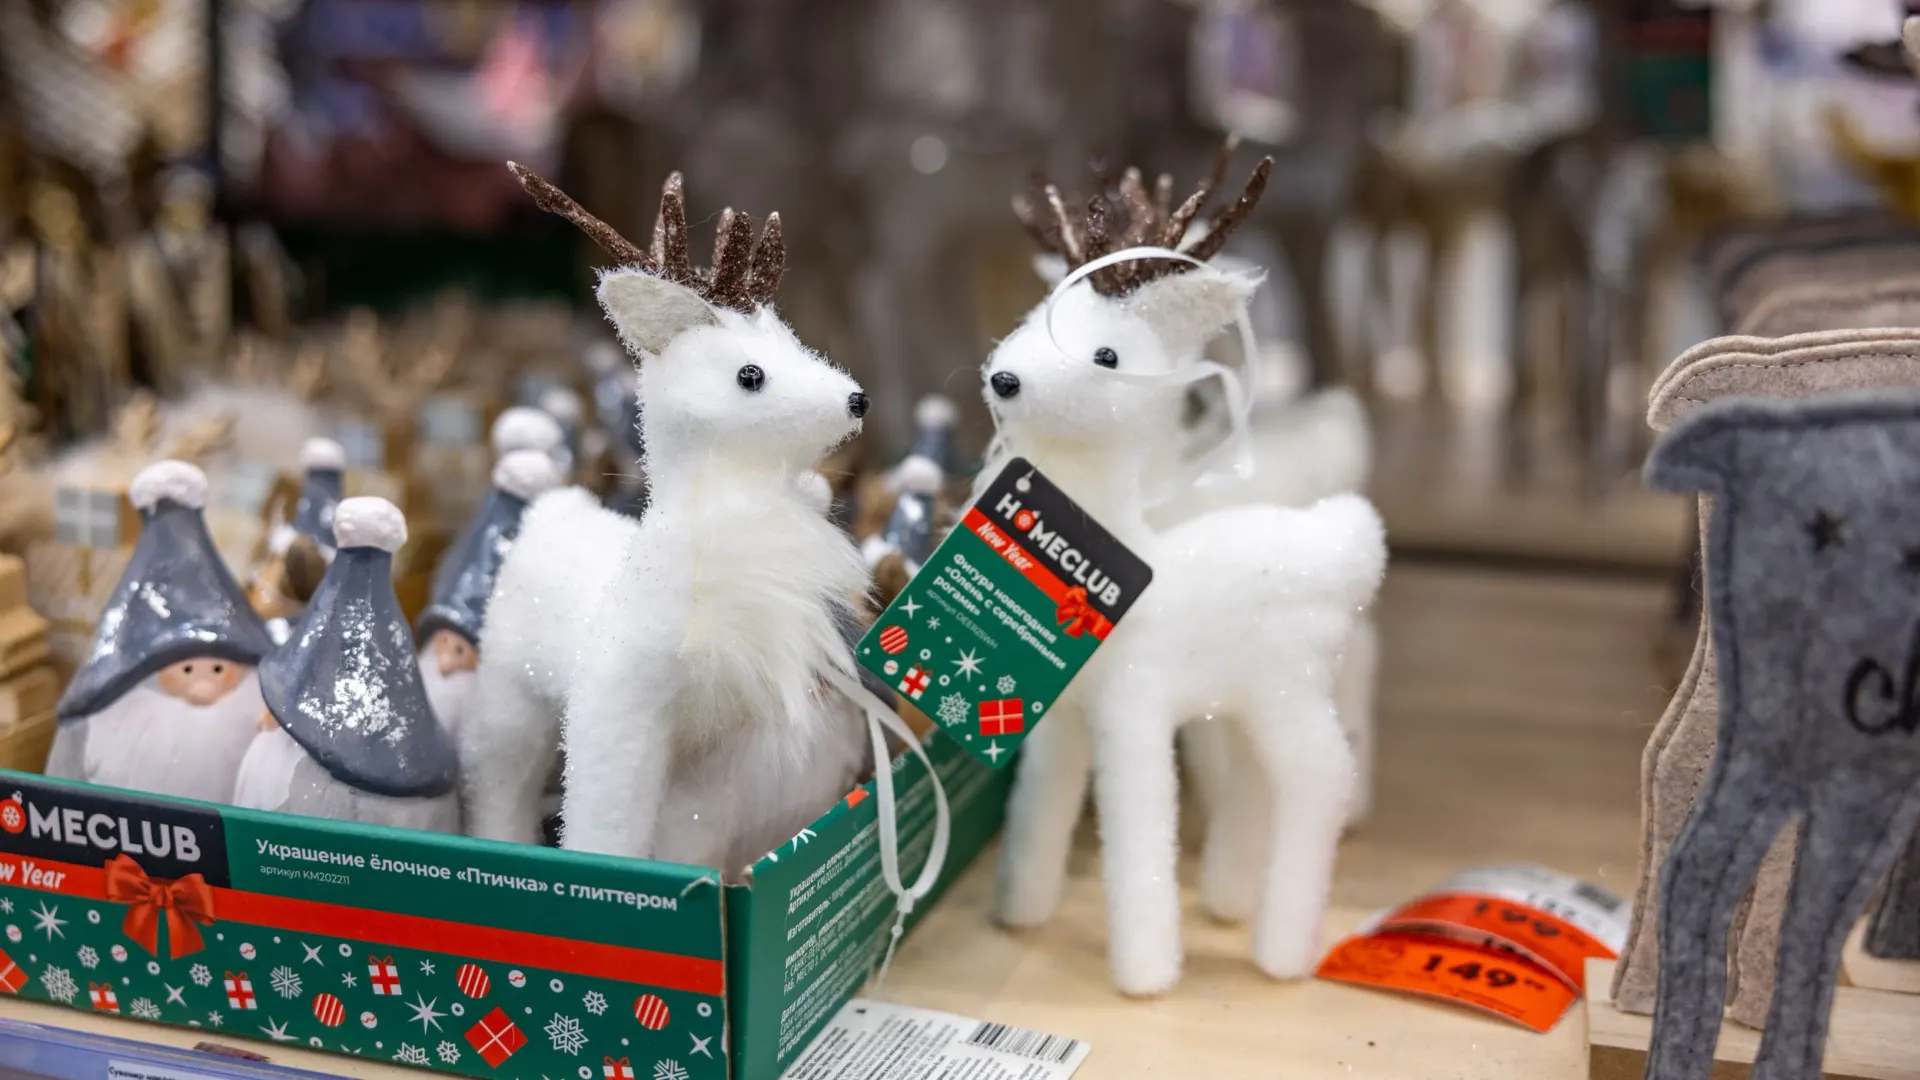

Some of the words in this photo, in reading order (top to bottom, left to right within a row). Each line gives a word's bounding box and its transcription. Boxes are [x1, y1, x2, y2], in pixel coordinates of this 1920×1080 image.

[977, 521, 1005, 548] New
[1003, 542, 1034, 571] Year
[995, 492, 1122, 607] HOMECLUB
[953, 553, 994, 592] Фигура
[994, 588, 1057, 645] новогодняя
[992, 605, 1066, 670] серебряными
[22, 860, 66, 889] Year
[256, 838, 366, 868] Украшение
[370, 850, 451, 880] ёлочное
[456, 867, 548, 893] «Птичка»
[553, 883, 564, 895] с
[570, 884, 677, 911] глиттером
[260, 864, 300, 880] артикул
[1423, 953, 1517, 988] 149
